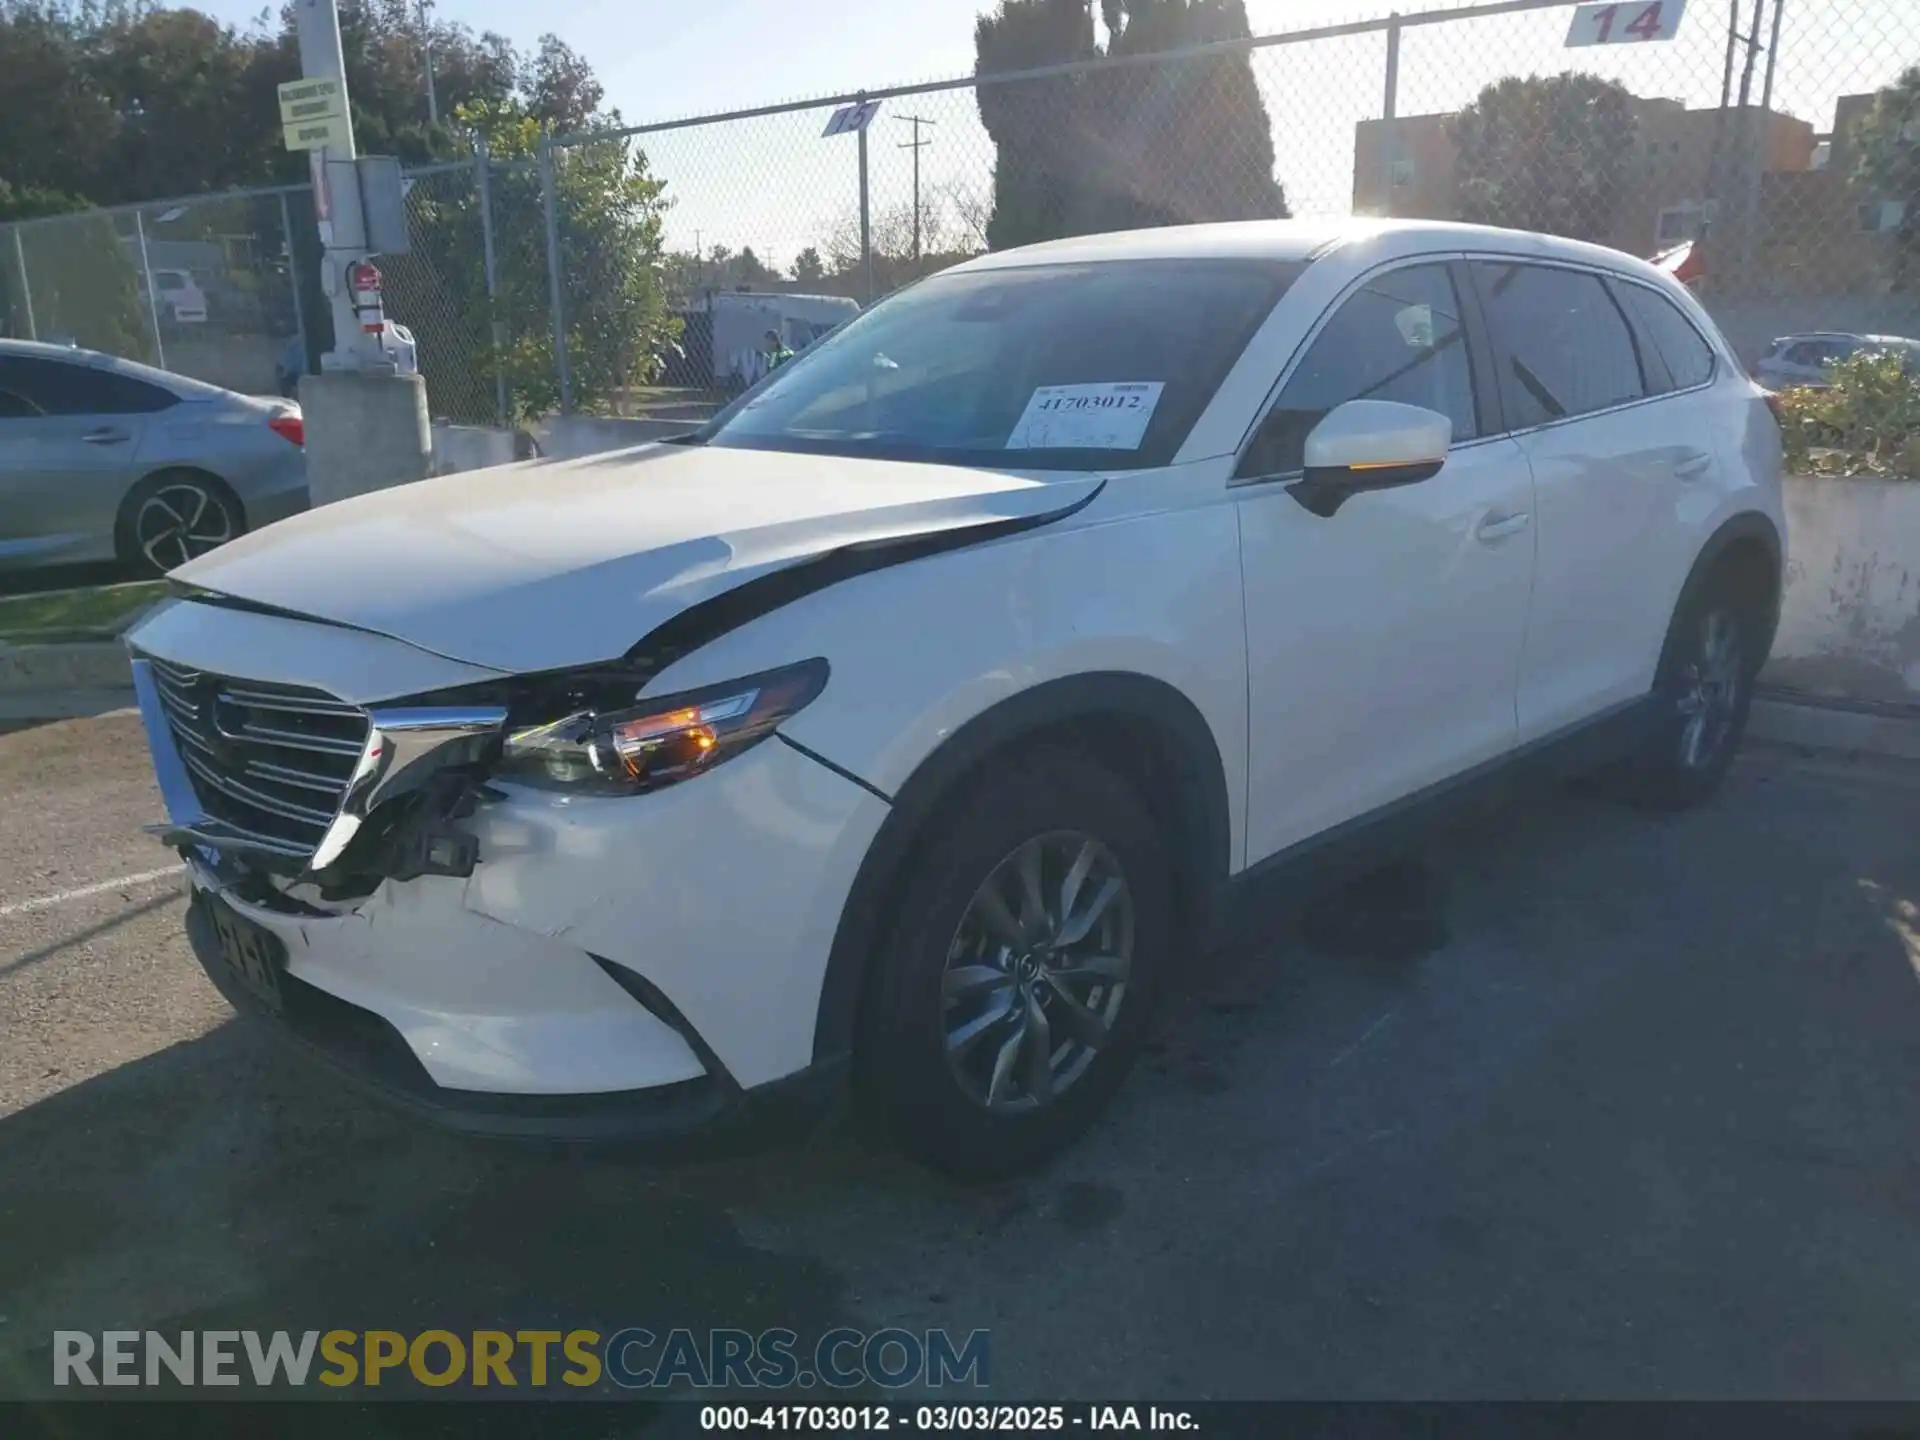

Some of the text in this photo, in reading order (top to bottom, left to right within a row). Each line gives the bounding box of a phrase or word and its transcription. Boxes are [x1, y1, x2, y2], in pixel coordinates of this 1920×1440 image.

[1592, 1, 1662, 42] 14
[835, 103, 872, 132] 15
[1038, 395, 1142, 411] 41703012
